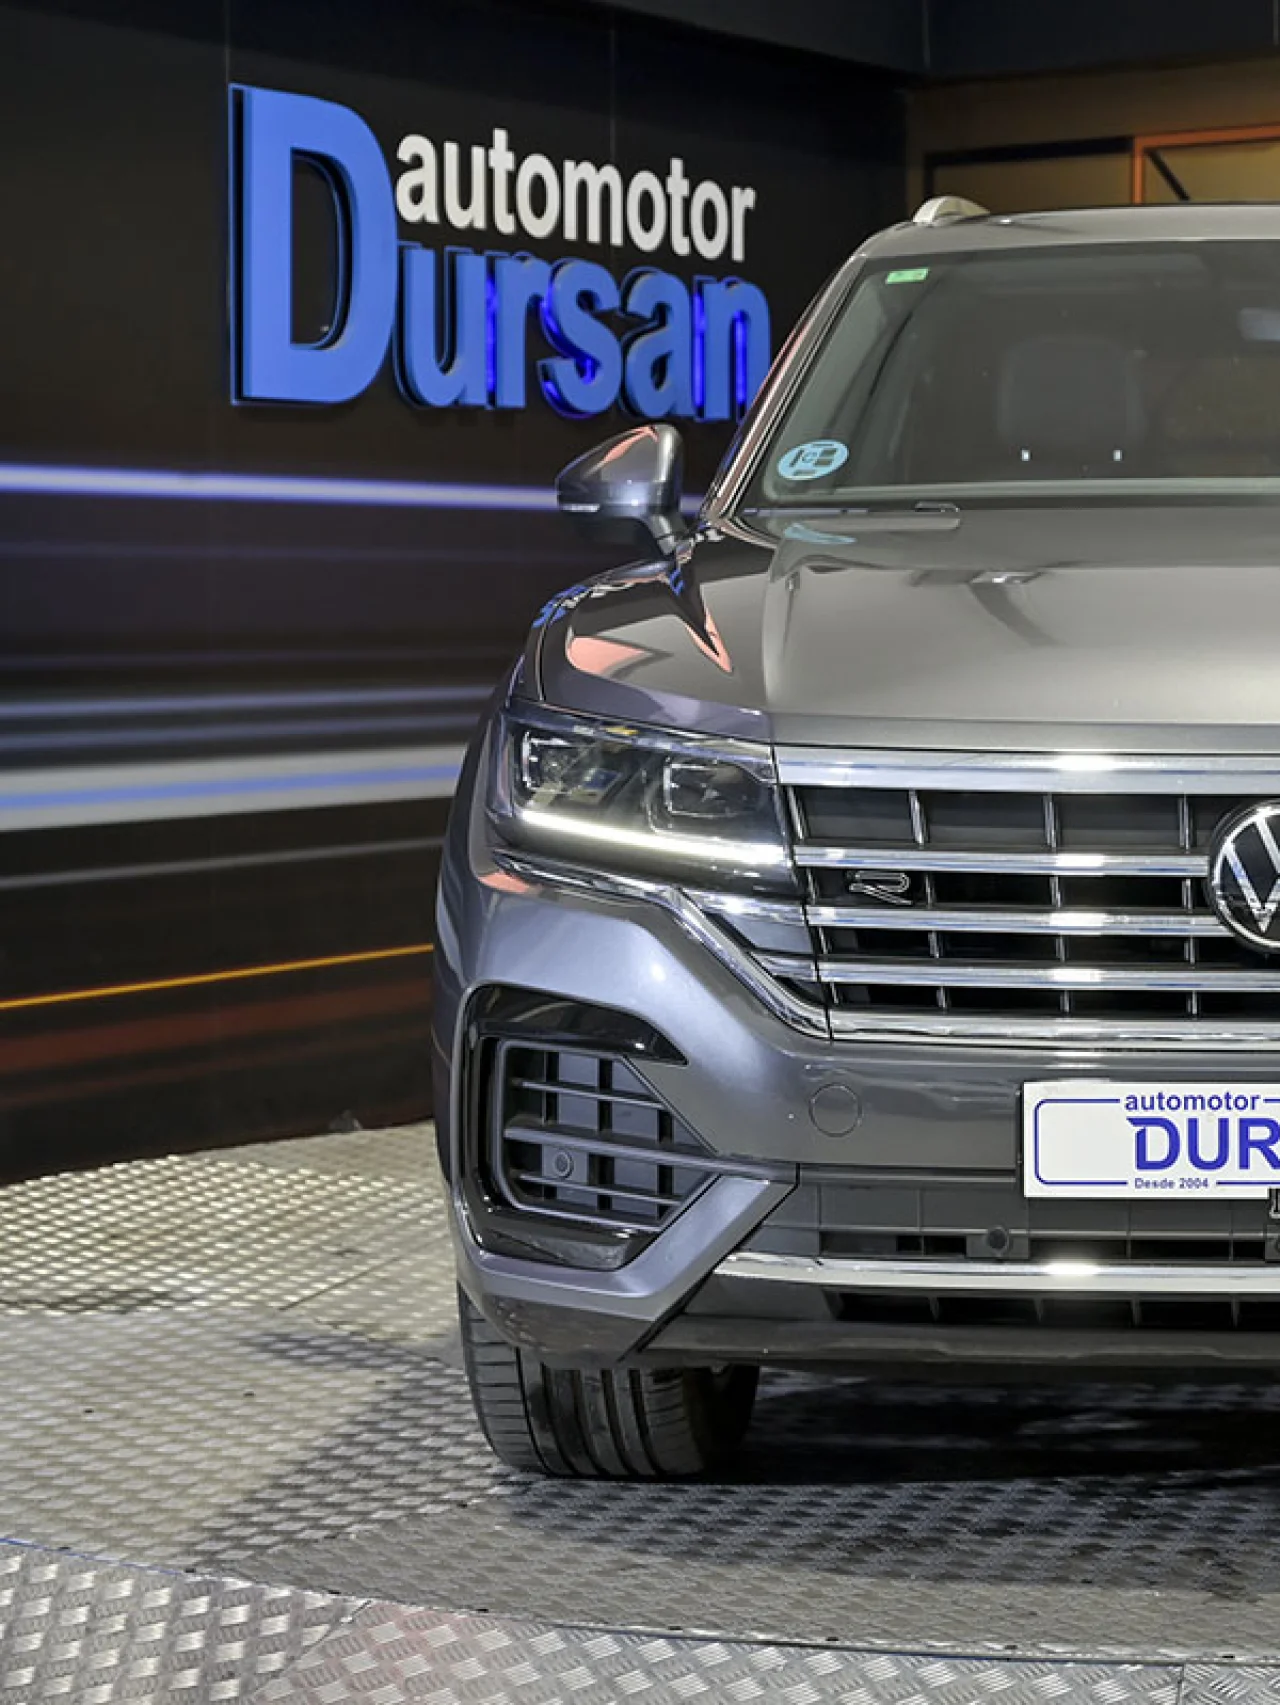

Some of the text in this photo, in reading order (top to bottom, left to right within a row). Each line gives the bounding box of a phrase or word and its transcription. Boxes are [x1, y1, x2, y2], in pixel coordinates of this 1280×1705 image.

[397, 128, 756, 262] automotor
[228, 82, 771, 422] Dursan
[1124, 1091, 1261, 1111] automotor
[1134, 1178, 1209, 1190] Desde 2004
